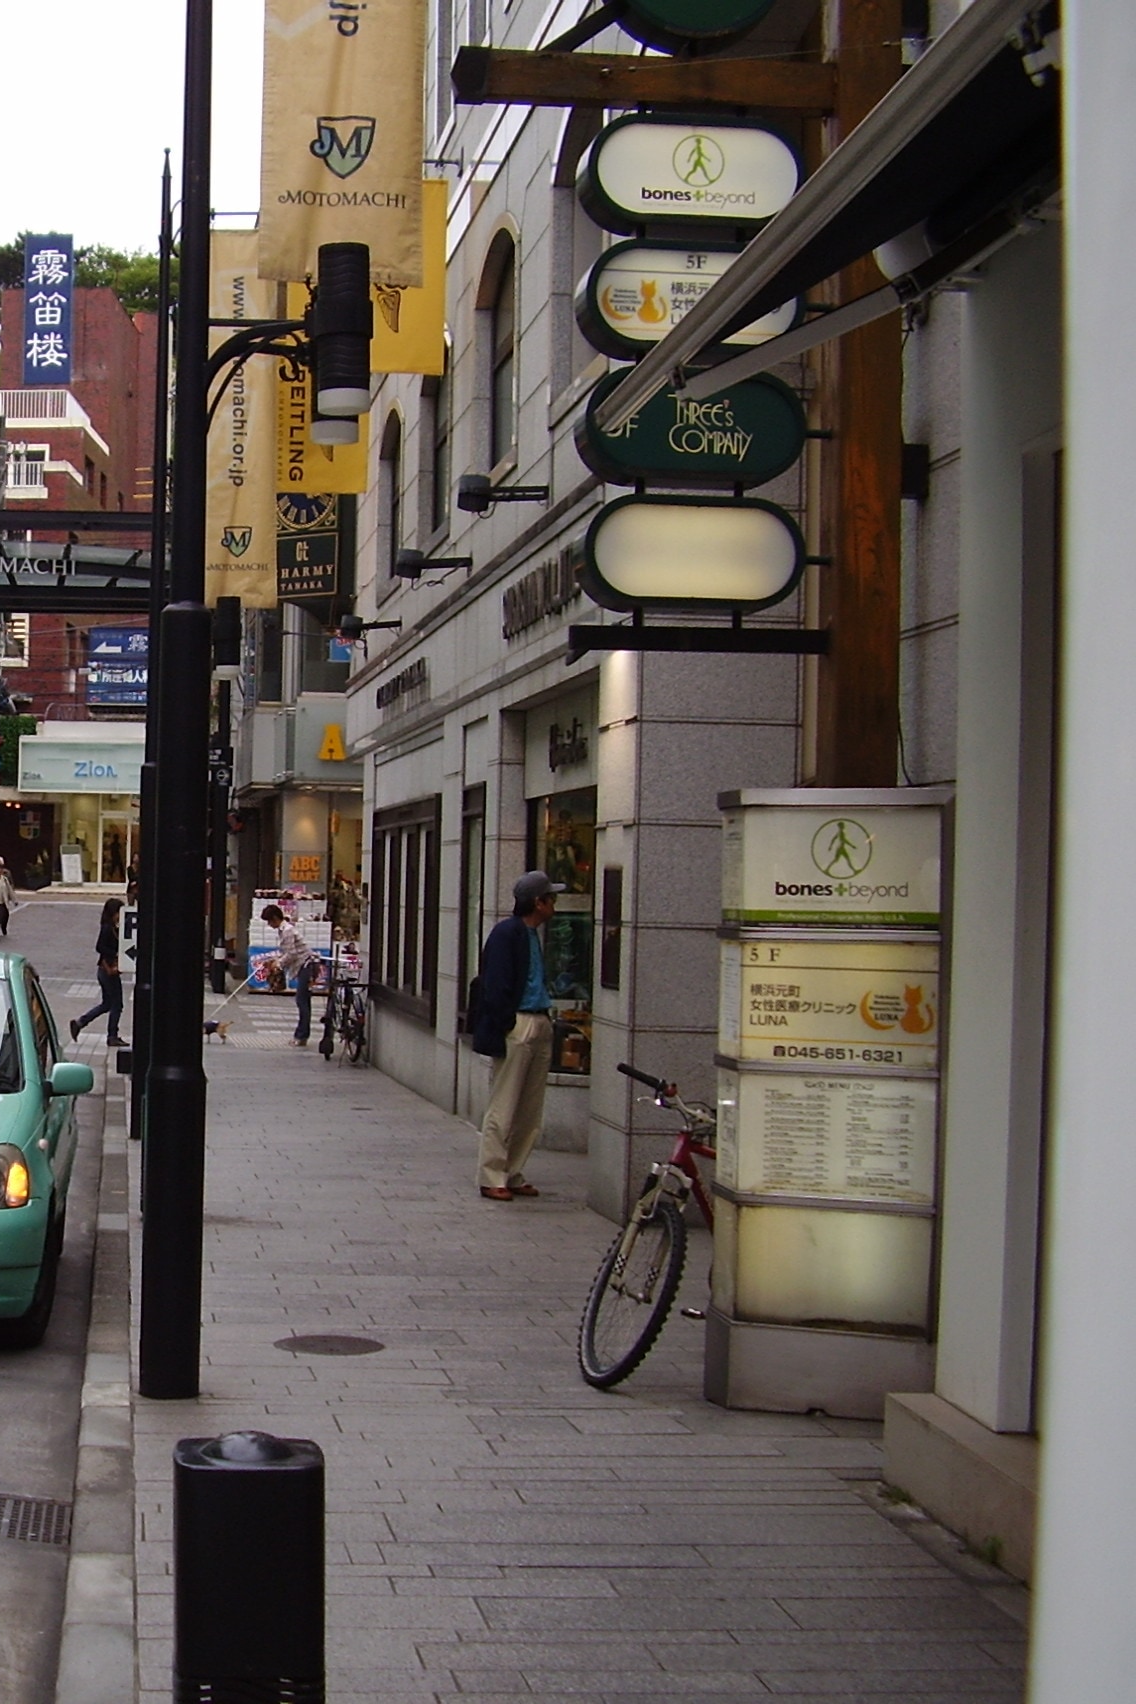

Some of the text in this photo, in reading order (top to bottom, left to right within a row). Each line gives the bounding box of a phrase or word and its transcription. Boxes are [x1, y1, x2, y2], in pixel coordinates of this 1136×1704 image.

[278, 190, 407, 210] MOTOMACHI
[686, 255, 707, 270] 5F
[26, 249, 70, 368] 霧笛楼
[289, 369, 307, 483] REITLING
[277, 565, 335, 579] HARMY
[280, 581, 323, 591] TANAKA
[74, 760, 117, 778] Zion
[290, 856, 321, 870] ABC
[750, 984, 801, 998] 横浜元町
[750, 1000, 857, 1015] 女性医療クリニック
[750, 1014, 788, 1026] LUNA
[788, 1046, 903, 1063] 045-651-6321
